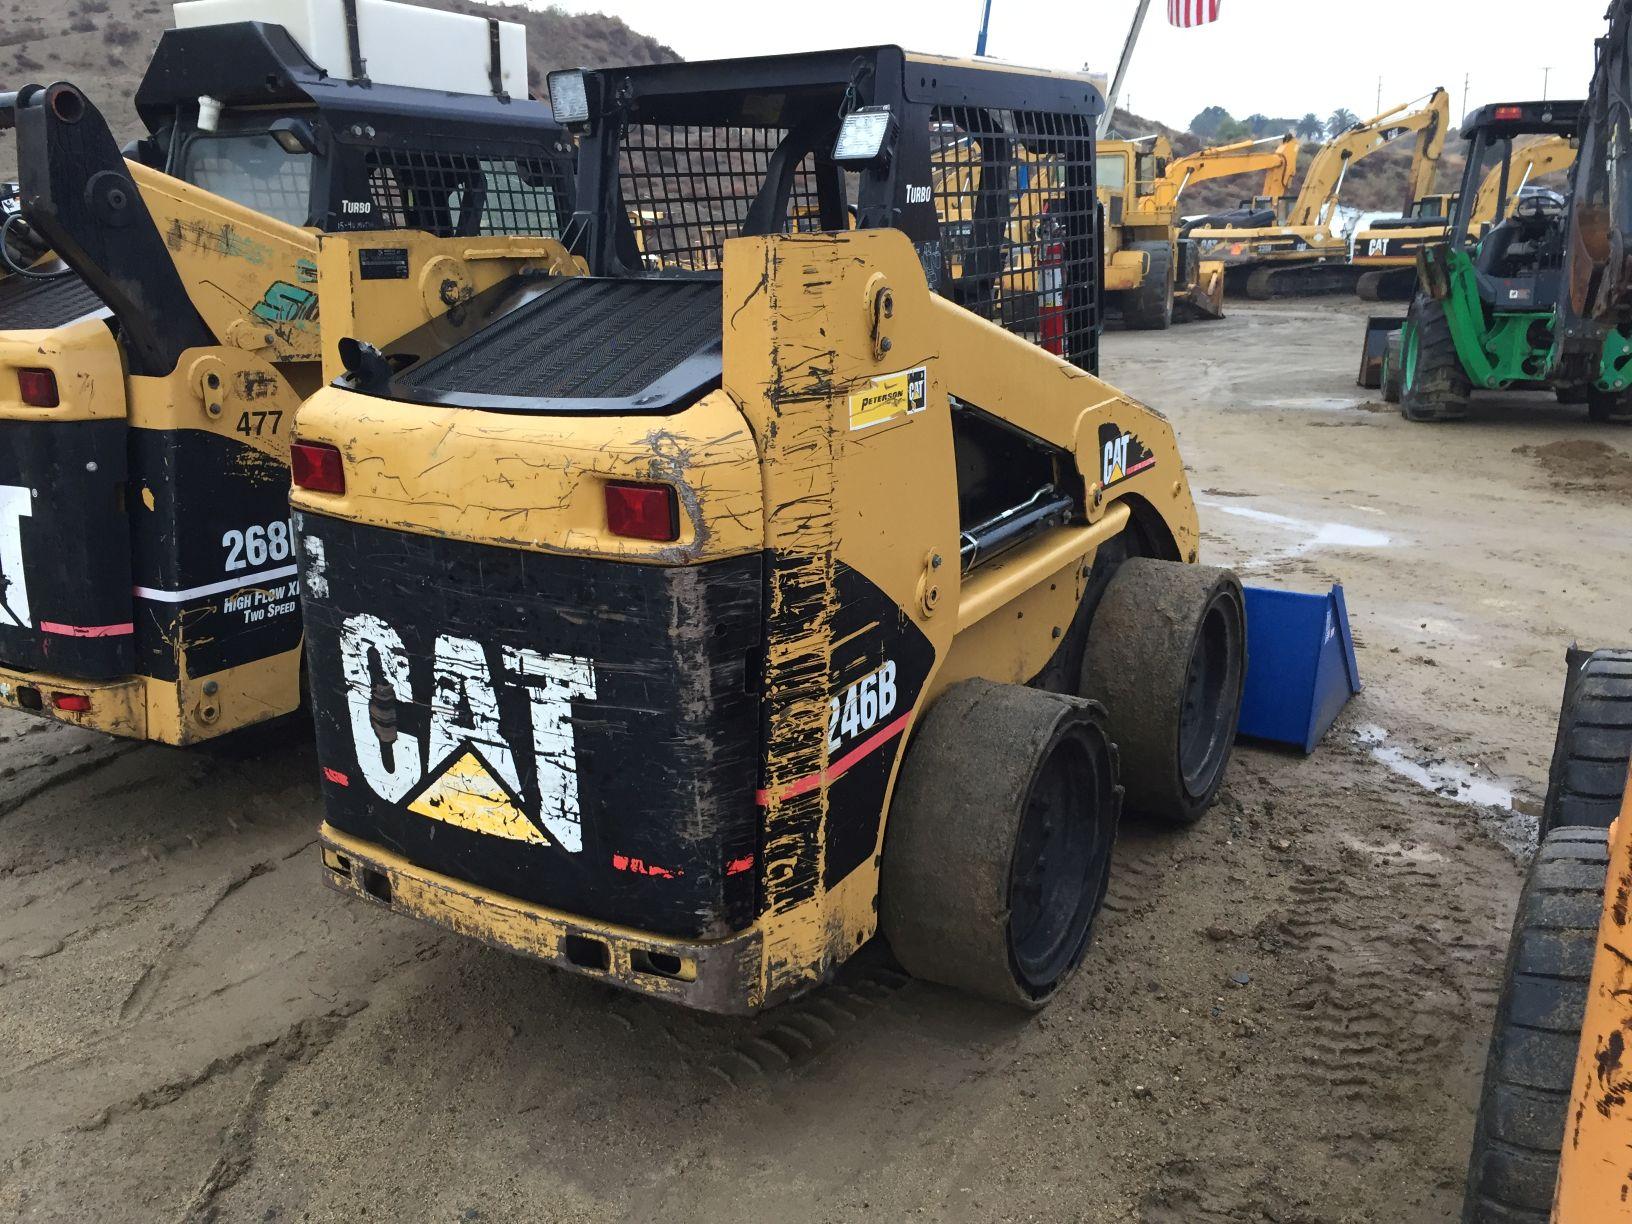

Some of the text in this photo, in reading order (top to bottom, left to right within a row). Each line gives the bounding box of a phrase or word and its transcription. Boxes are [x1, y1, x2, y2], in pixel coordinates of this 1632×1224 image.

[342, 199, 371, 214] TURBO
[906, 184, 932, 203] TURBO
[1368, 238, 1390, 256] CAT
[861, 380, 924, 411] PETERSON CAT
[236, 410, 283, 436] 477
[1103, 434, 1130, 486] CAT
[223, 595, 253, 614] HIGH
[254, 586, 286, 606] FLOW
[243, 601, 296, 623] TWO SPEED
[828, 659, 897, 756] 246B
[339, 612, 597, 853] CAT
